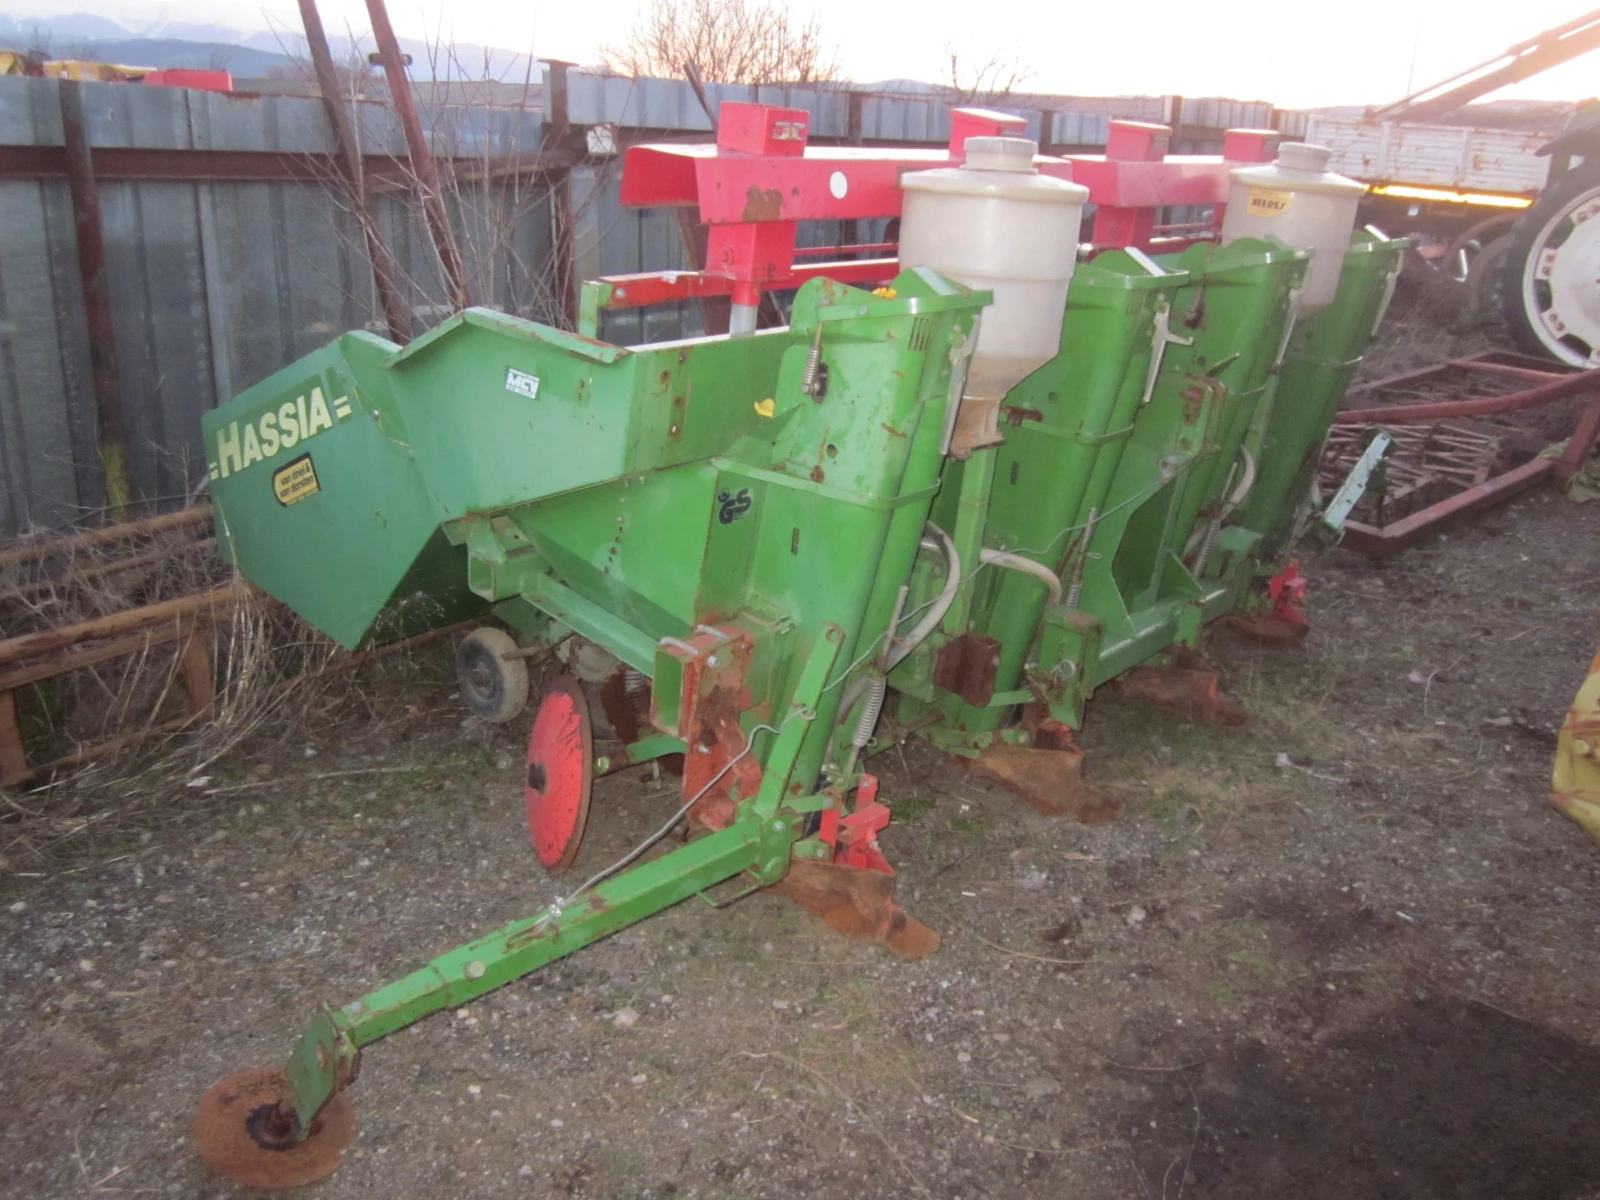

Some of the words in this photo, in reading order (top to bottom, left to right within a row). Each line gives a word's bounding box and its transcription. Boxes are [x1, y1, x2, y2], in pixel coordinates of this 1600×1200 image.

[506, 372, 540, 394] MCV
[216, 386, 333, 479] HASSIA
[281, 475, 292, 486] van
[280, 487, 291, 498] van
[719, 487, 752, 525] GS
